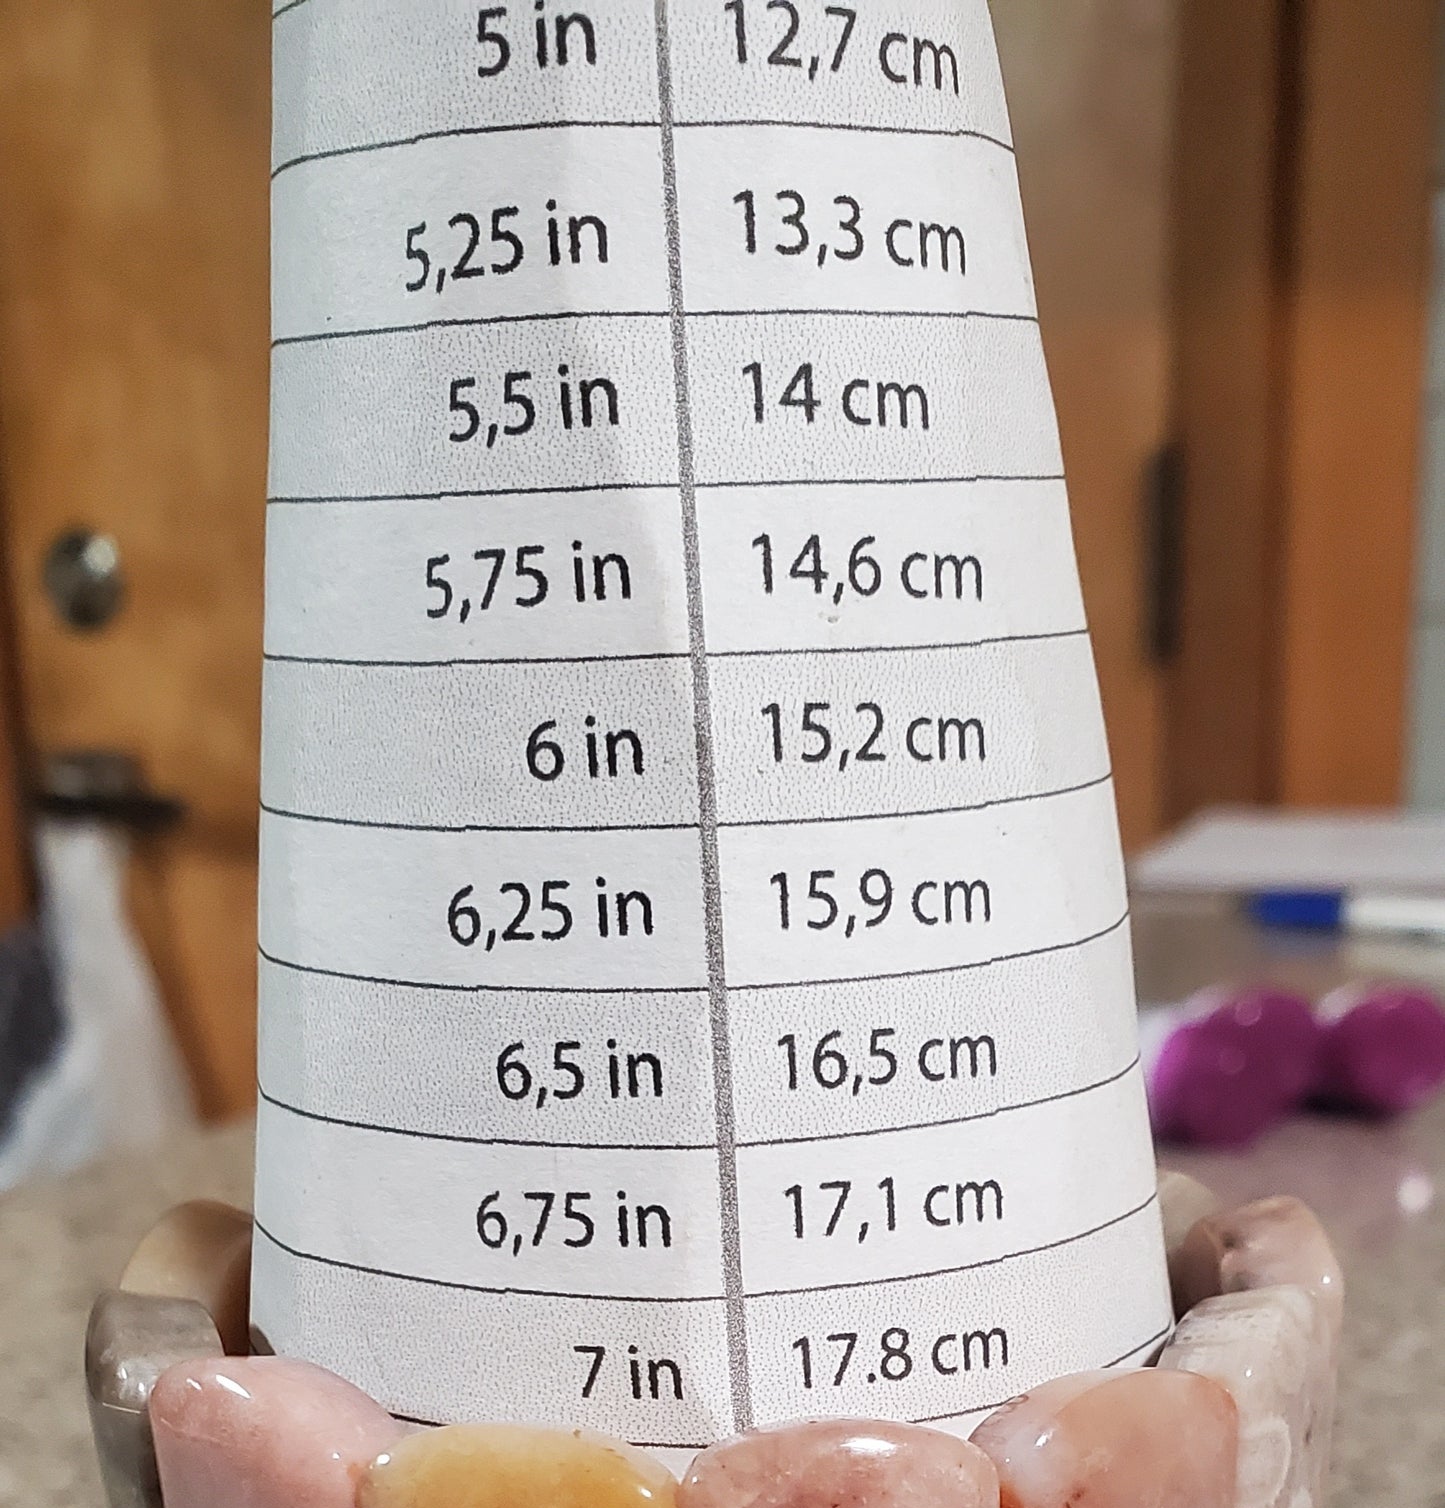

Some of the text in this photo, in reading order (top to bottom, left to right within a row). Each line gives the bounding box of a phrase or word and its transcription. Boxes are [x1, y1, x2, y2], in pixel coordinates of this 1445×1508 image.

[476, 0, 597, 78] 5 in
[724, 0, 960, 96] 12,7 cm
[405, 198, 608, 294] 5,25 in
[733, 189, 966, 276] 13,3 cm
[449, 363, 619, 449] 5,5 in
[742, 361, 930, 431] 14 cm
[426, 539, 631, 624] 5,75 in
[752, 532, 983, 606] 14,6 cm
[525, 714, 645, 782] 6 in
[761, 701, 986, 772] 15,2 cm
[447, 876, 654, 952] 6,25 in
[770, 868, 991, 939] 15,9 cm
[496, 1038, 663, 1110] 6,5 in
[777, 1027, 997, 1097] 16,5 cm
[476, 1190, 672, 1257] 6,75 in
[784, 1176, 1004, 1244] 17,1 cm
[573, 1344, 684, 1401] 7 in
[792, 1327, 1009, 1389] 17.8 cm
